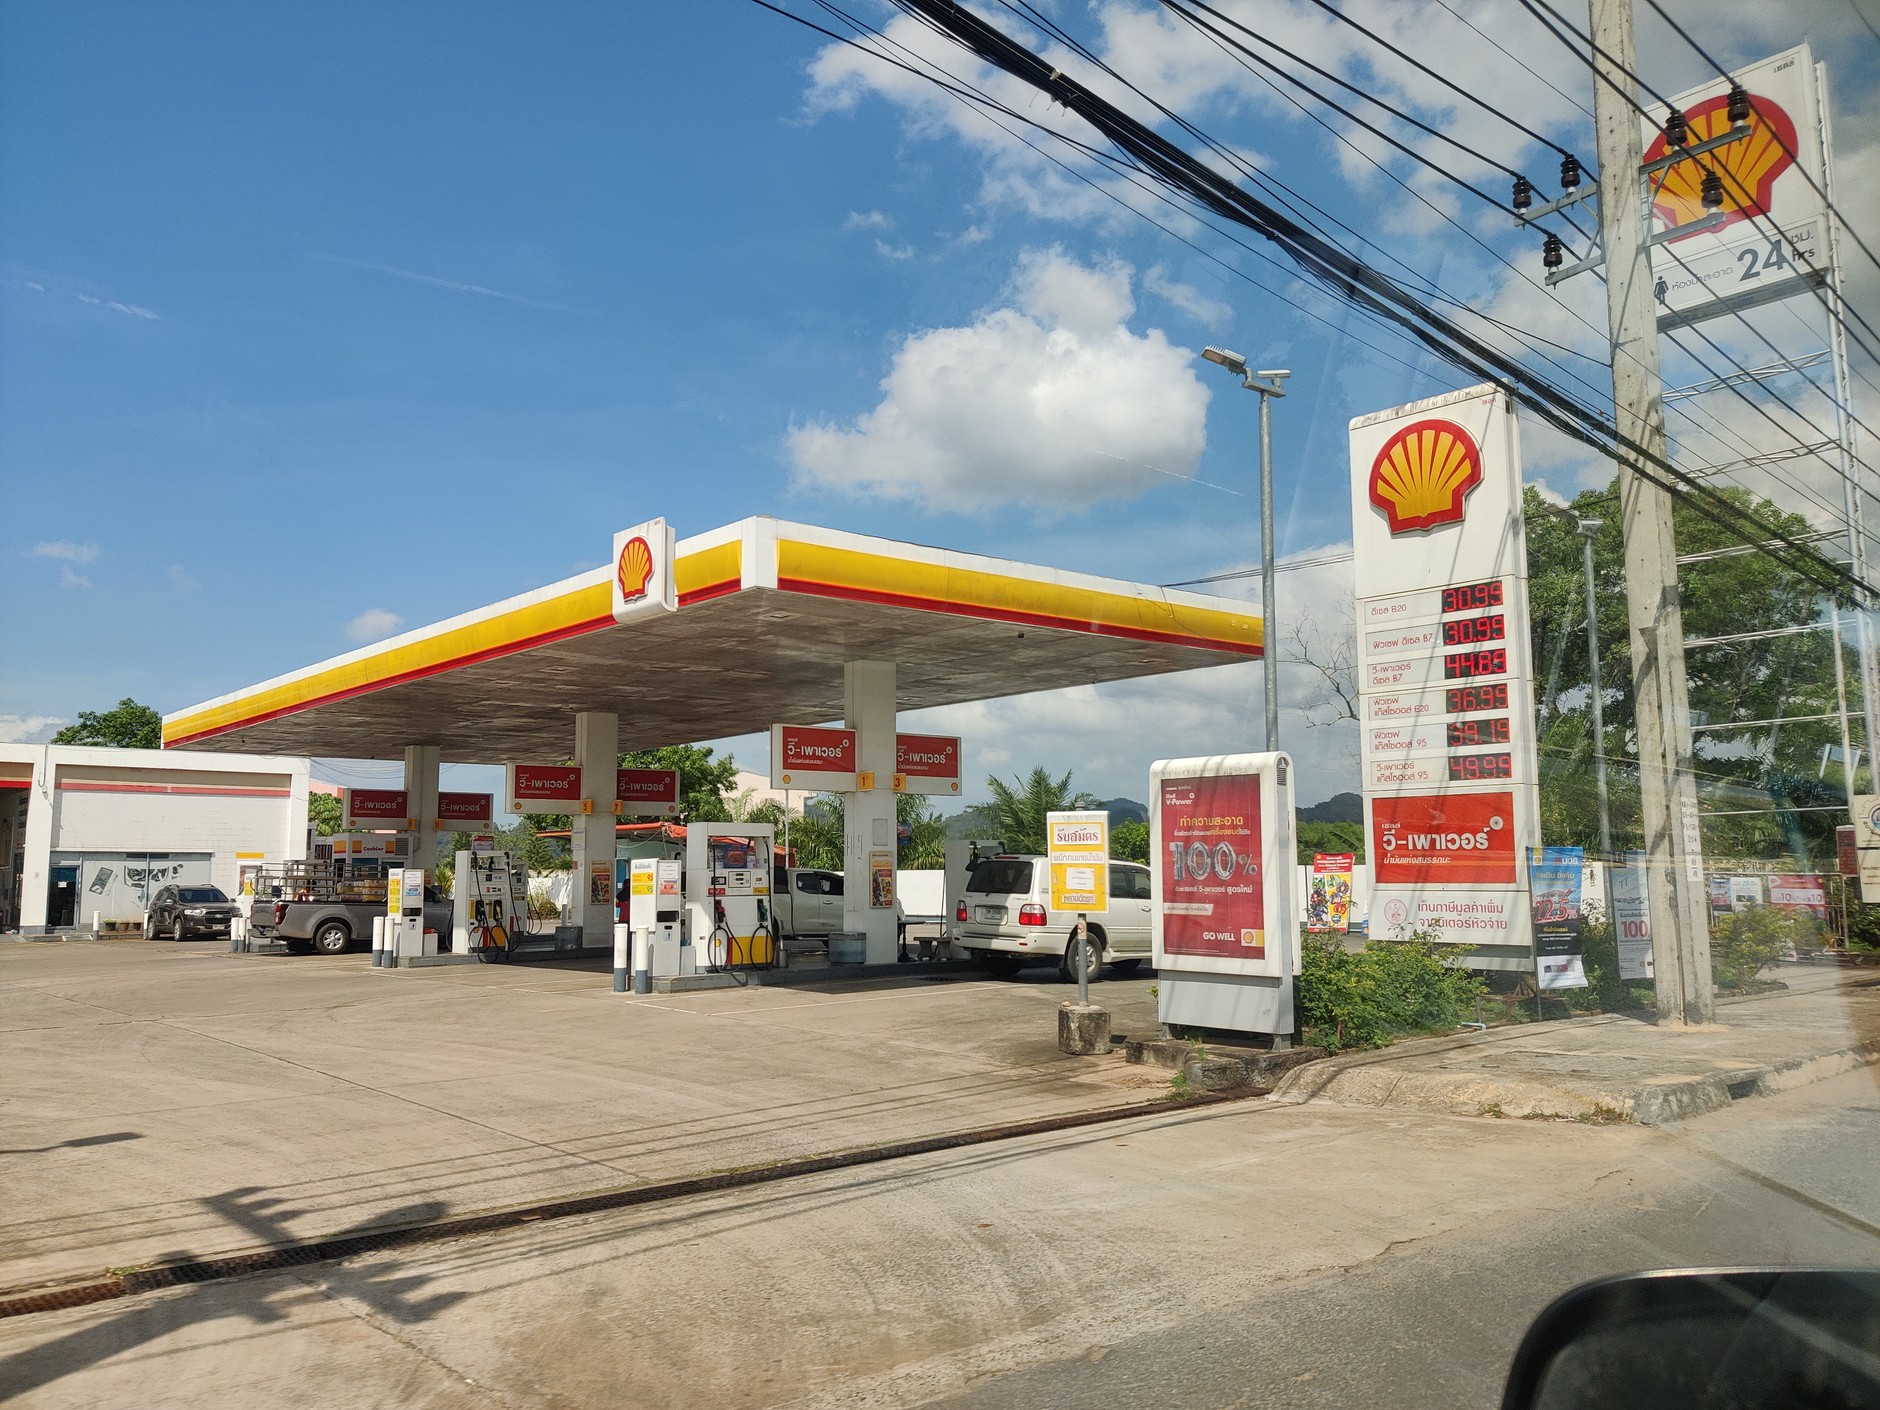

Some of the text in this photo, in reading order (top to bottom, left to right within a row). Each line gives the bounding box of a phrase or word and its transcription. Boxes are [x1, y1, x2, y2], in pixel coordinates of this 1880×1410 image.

[1737, 239, 1788, 282] 24
[1444, 582, 1504, 612] 30.99
[1391, 604, 1407, 613] B20
[1423, 633, 1433, 642] B7
[1446, 616, 1506, 645] 30.99
[1446, 649, 1507, 677] 44.89
[1393, 674, 1402, 682] B7
[1448, 685, 1509, 712] 36.99
[1415, 705, 1429, 713] E20
[1449, 719, 1511, 746] 39.19
[788, 742, 843, 757] วี-เพาเวอร์
[1416, 739, 1427, 747] 95
[897, 749, 946, 763] วี-เพาเวอร์
[1450, 756, 1512, 779] 49.99
[519, 776, 569, 788] วี-เพาเวอร์
[894, 777, 901, 788] 3
[1417, 771, 1428, 780] 95
[1180, 815, 1243, 827] ทำความสะอาด
[1056, 828, 1099, 842] รับสมัคร
[1382, 828, 1490, 851] วี-เพาเวอร์
[1169, 841, 1258, 880] 100%
[1562, 857, 1579, 865] UOB
[1417, 899, 1504, 916] เก็บภาษีมูลค่าเพิ่ม
[1203, 931, 1236, 940] GO WELL
[1621, 920, 1649, 938] 100
